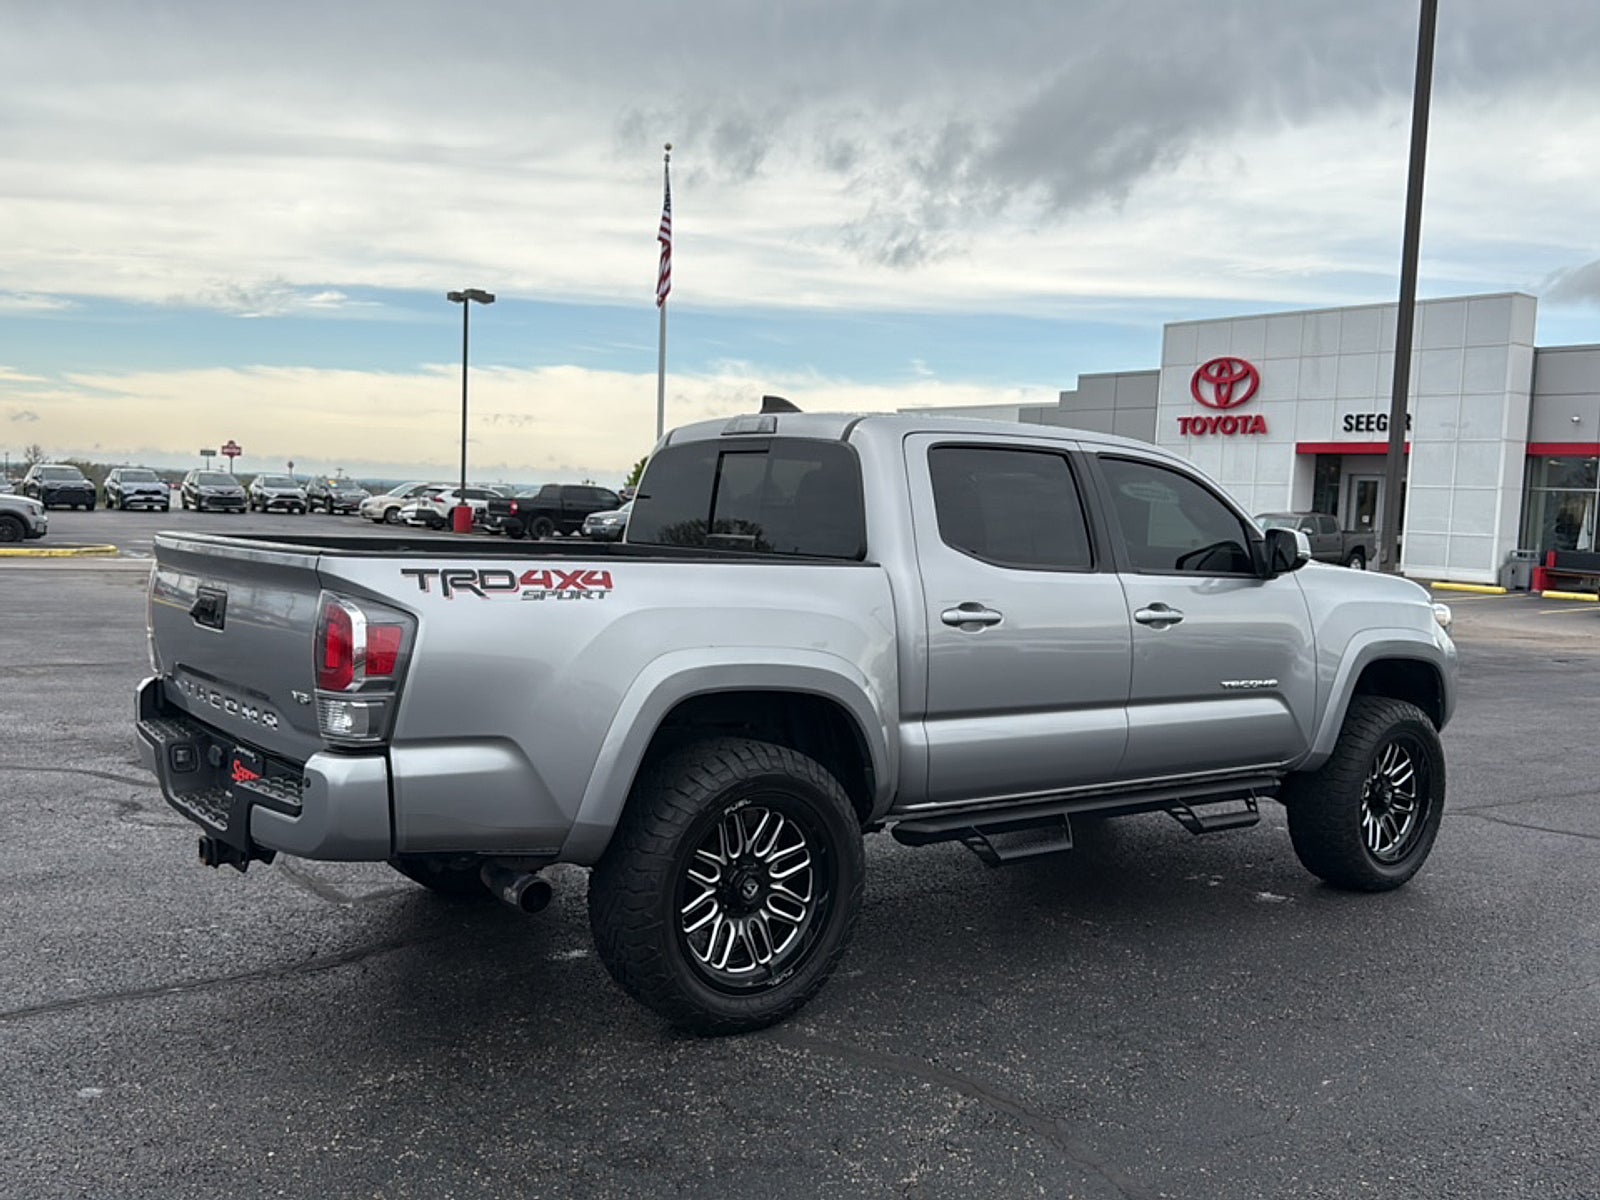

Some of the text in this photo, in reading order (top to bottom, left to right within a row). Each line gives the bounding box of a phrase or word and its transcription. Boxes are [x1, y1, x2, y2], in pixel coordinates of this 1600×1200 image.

[1177, 415, 1267, 435] TOYOTA
[1343, 413, 1412, 432] SEEGR
[401, 568, 519, 600] TRD
[521, 589, 611, 600] SPORT
